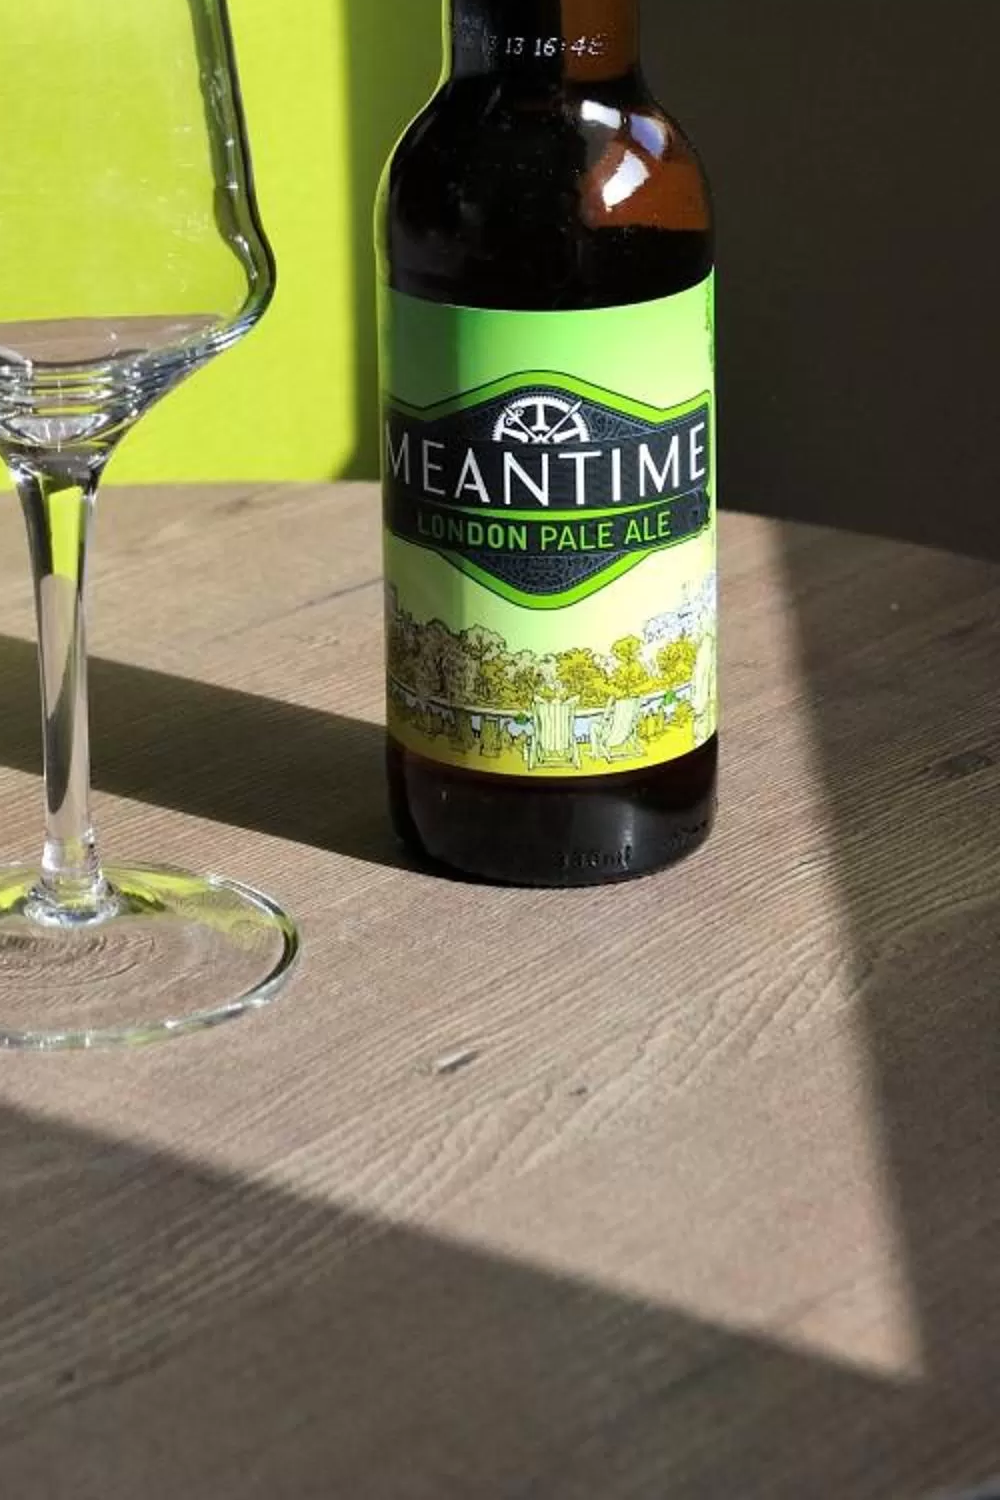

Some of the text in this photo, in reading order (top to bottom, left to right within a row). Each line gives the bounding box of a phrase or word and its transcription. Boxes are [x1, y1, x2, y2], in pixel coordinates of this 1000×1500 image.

[385, 418, 706, 508] MEANTIME
[416, 510, 672, 551] LONDON PALE ALE
